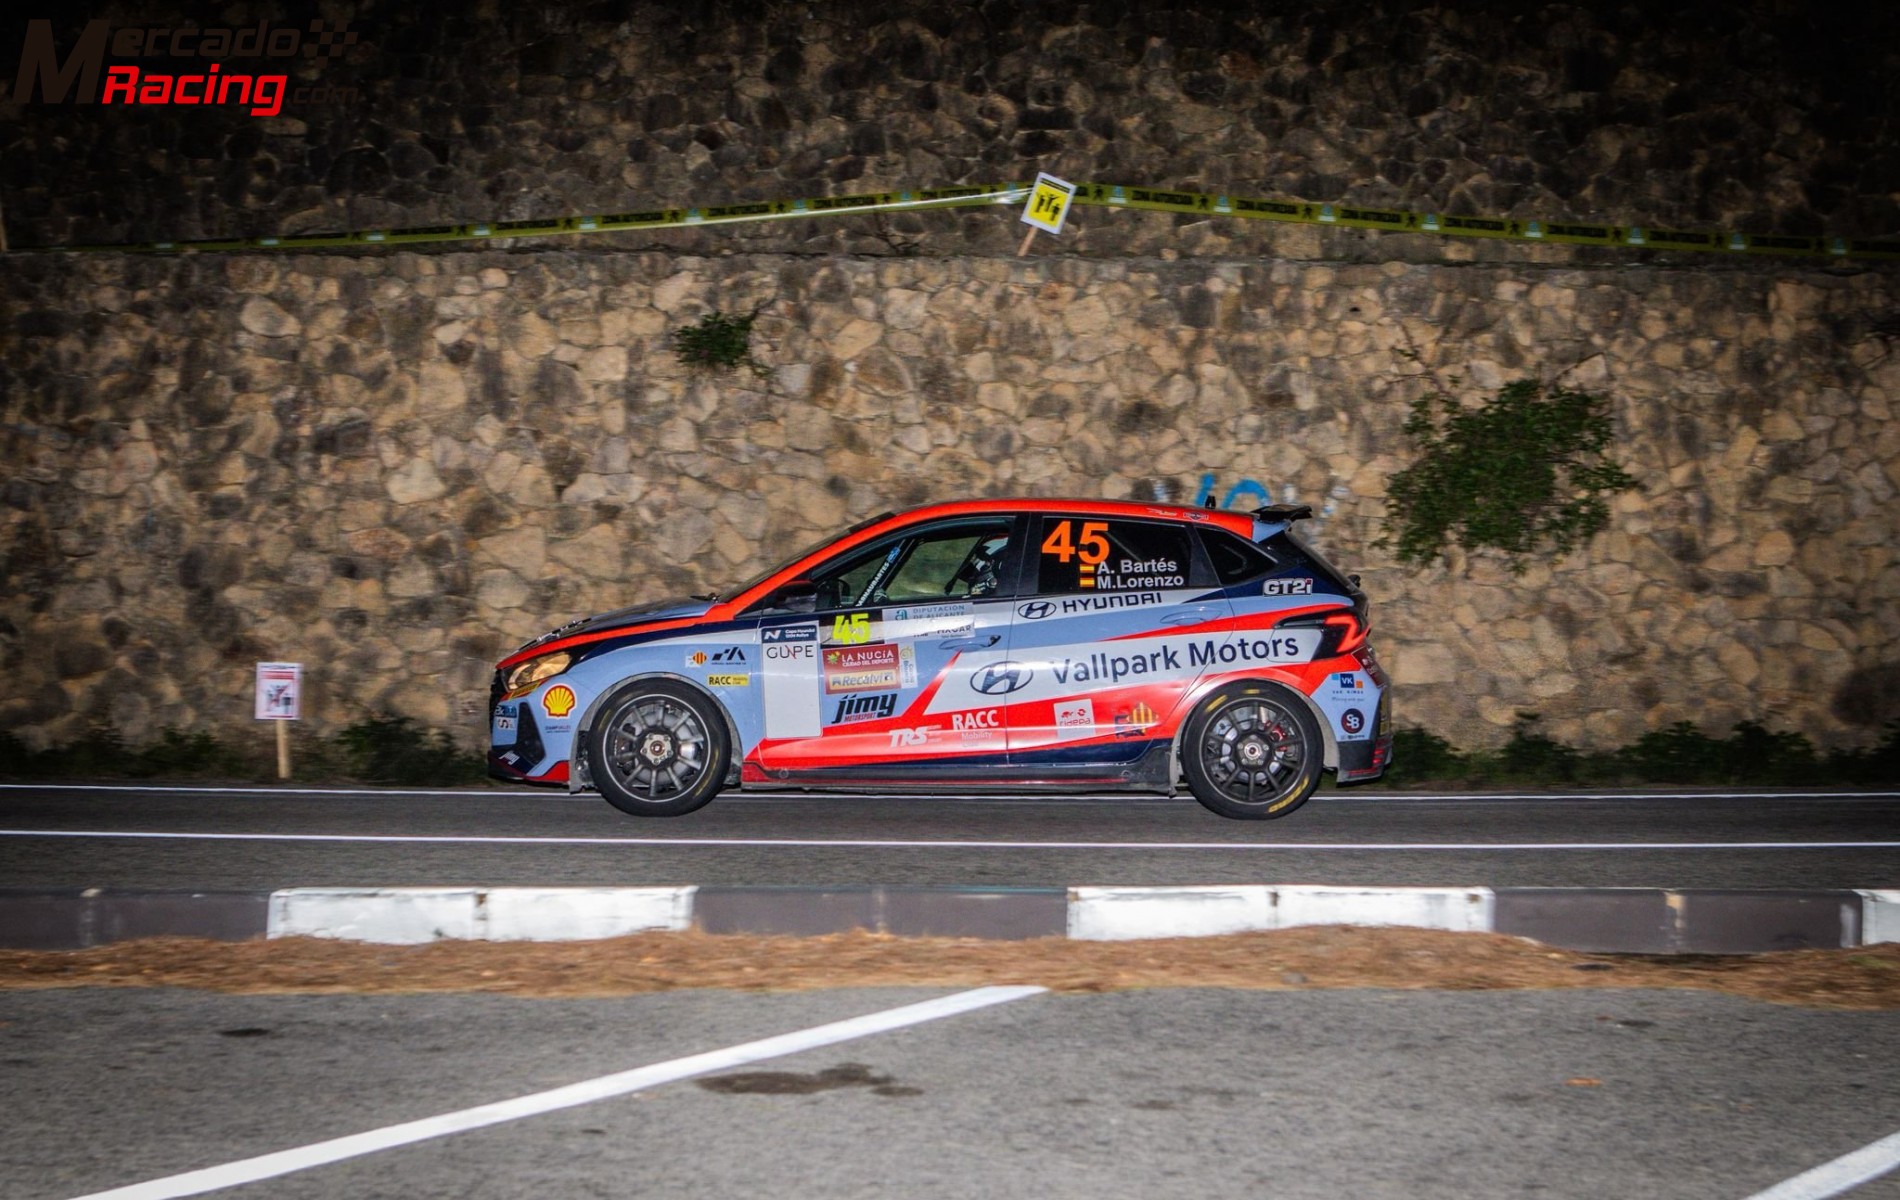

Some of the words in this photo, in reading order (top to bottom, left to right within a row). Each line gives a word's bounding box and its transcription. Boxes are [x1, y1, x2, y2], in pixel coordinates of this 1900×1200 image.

[1042, 520, 1110, 565] 45
[1097, 560, 1115, 575] A.
[1120, 558, 1178, 574] Bartés
[1062, 592, 1162, 613] HYUNDAI
[831, 613, 872, 645] 45
[842, 653, 854, 663] LA
[1049, 644, 1181, 684] Vallpark
[1188, 636, 1300, 667] Motors
[709, 676, 732, 686] RACC
[1341, 677, 1353, 685] VK
[952, 709, 999, 731] RACC
[889, 727, 928, 748] TRS
[961, 731, 992, 741] Mobility
